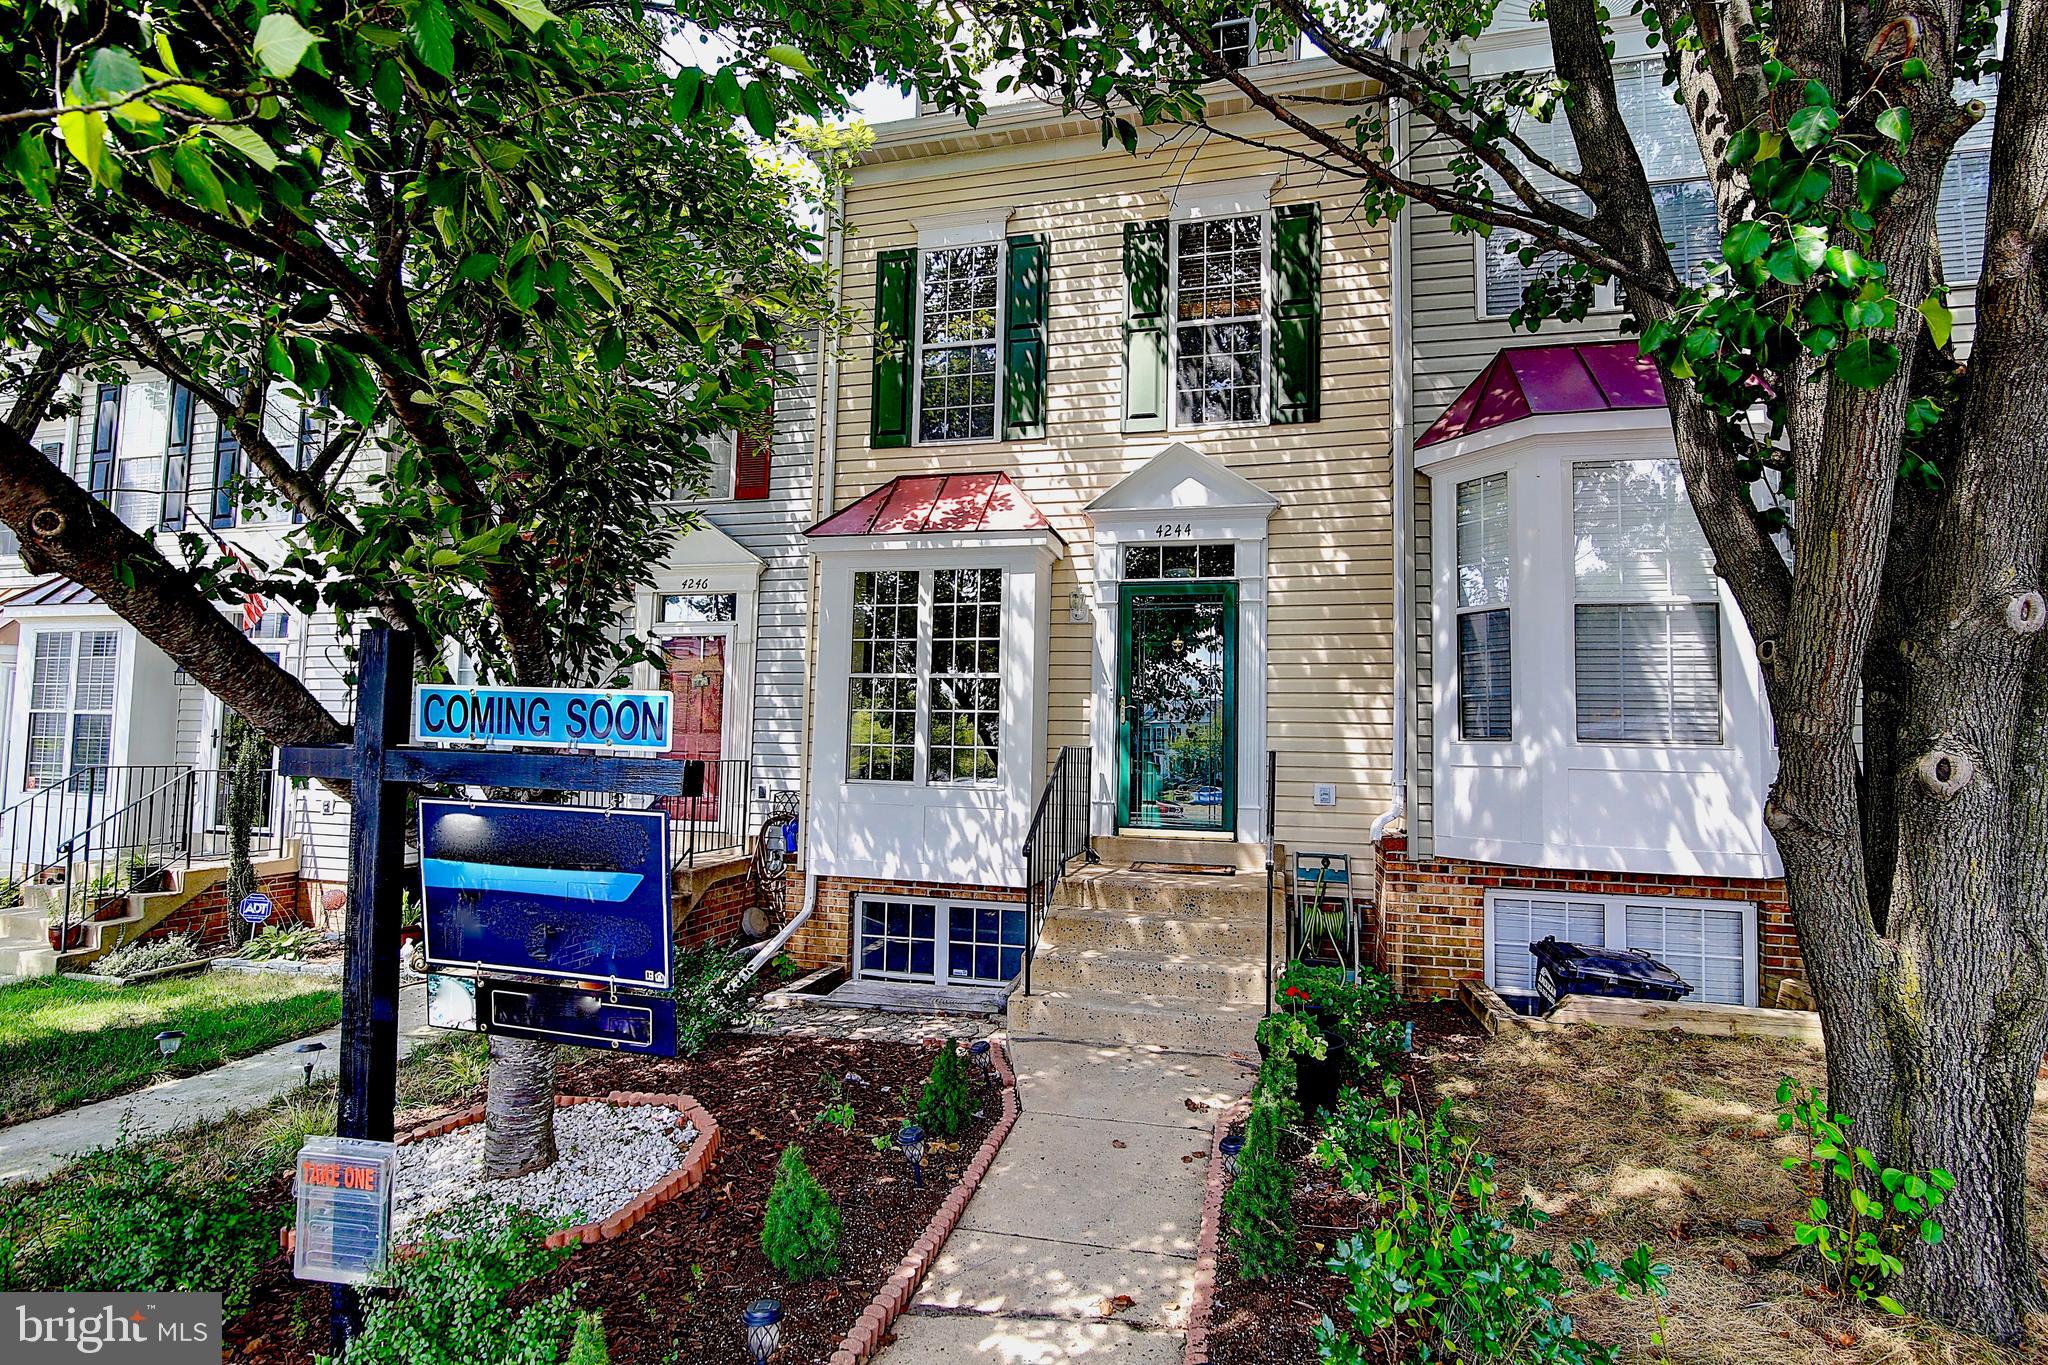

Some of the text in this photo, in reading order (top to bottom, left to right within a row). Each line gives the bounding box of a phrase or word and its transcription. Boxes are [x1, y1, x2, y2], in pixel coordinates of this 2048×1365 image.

[1156, 523, 1191, 538] 4244
[682, 578, 708, 589] 4246
[423, 693, 664, 741] COMING SOON
[244, 902, 269, 915] ADT
[302, 1160, 376, 1191] TAKE ONE
